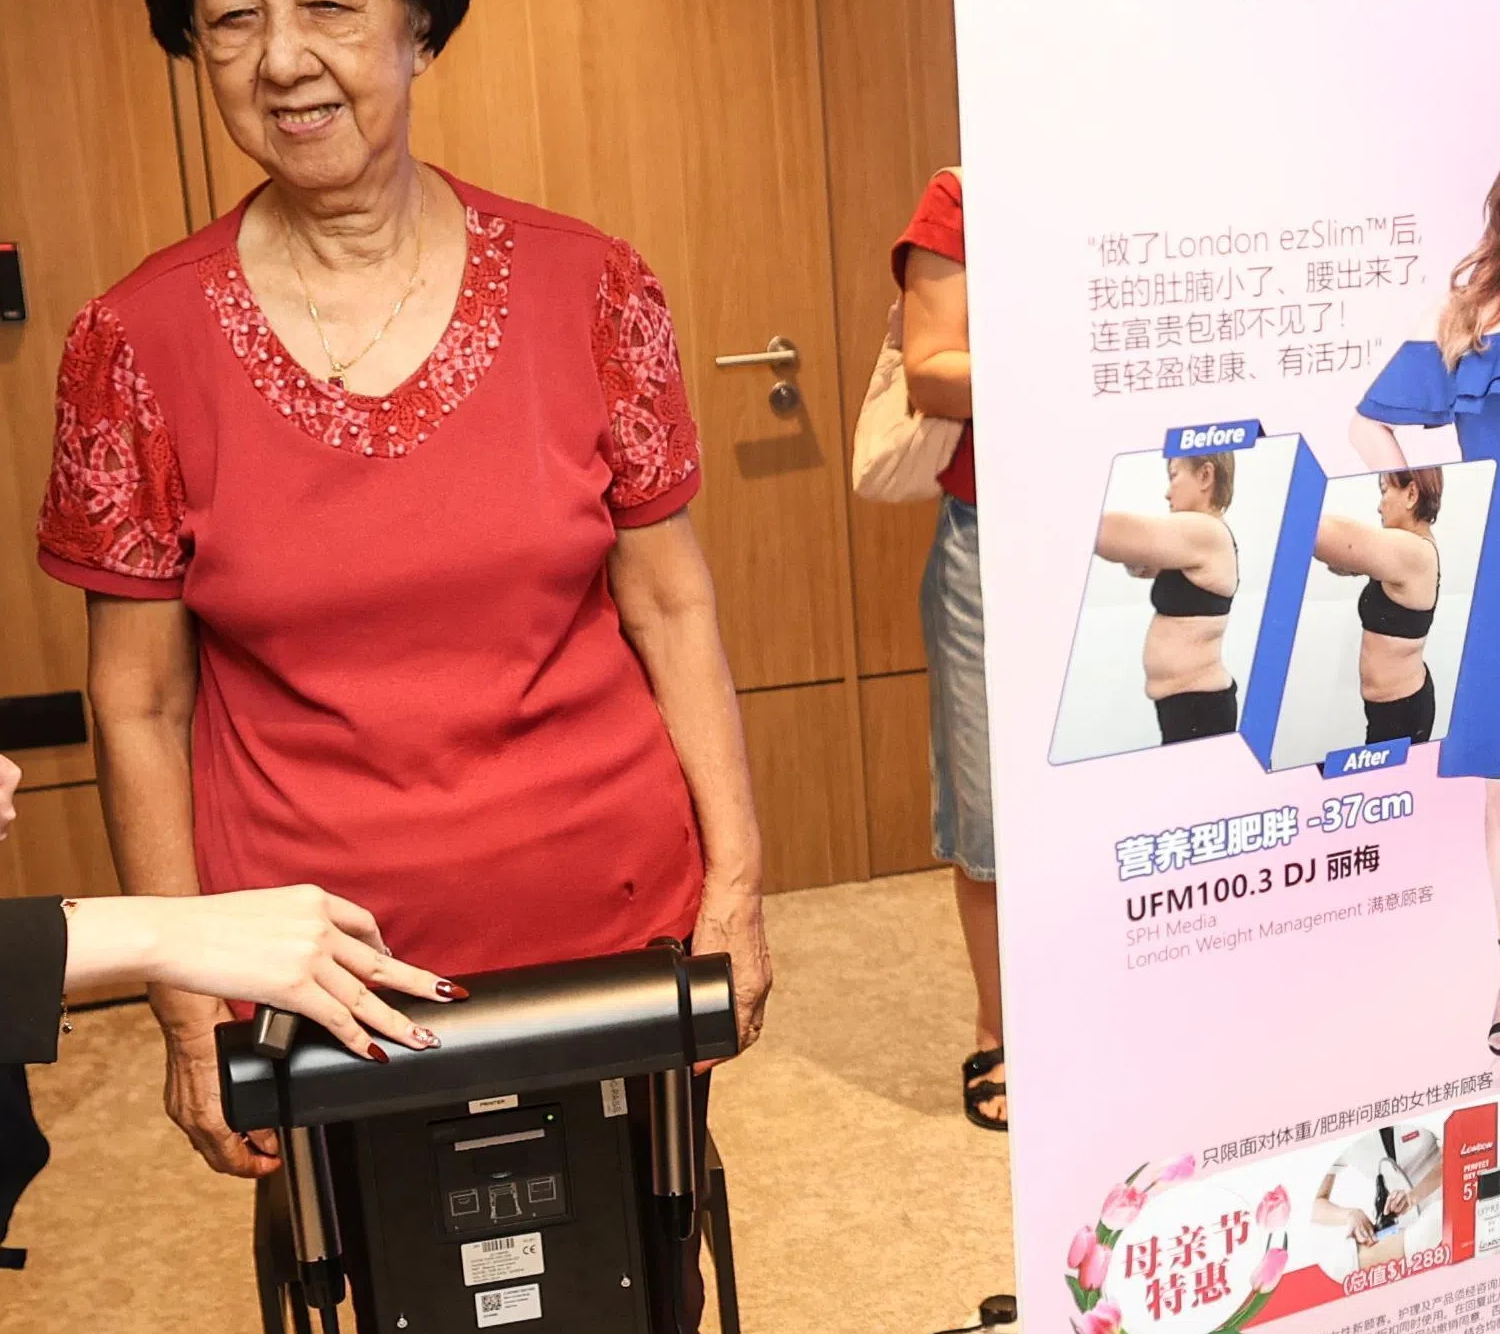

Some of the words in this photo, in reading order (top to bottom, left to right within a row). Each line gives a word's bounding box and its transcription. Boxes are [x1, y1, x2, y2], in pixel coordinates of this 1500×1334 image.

[1180, 423, 1246, 450] Before
[1343, 747, 1390, 772] After
[1114, 806, 1299, 882] 营养型肥胖
[1306, 791, 1414, 835] -37cm
[1126, 868, 1273, 922] UFM100.3
[1284, 858, 1317, 888] DJ
[1326, 844, 1381, 882] 丽梅
[1126, 926, 1160, 948] SPH
[1166, 914, 1218, 938] Media
[1127, 943, 1190, 970] London
[1196, 928, 1253, 954] Weight
[1259, 904, 1363, 937] Management
[1367, 885, 1435, 916] 满意顾客
[1123, 1207, 1252, 1280] 母亲节
[1146, 1260, 1232, 1322] 特惠
